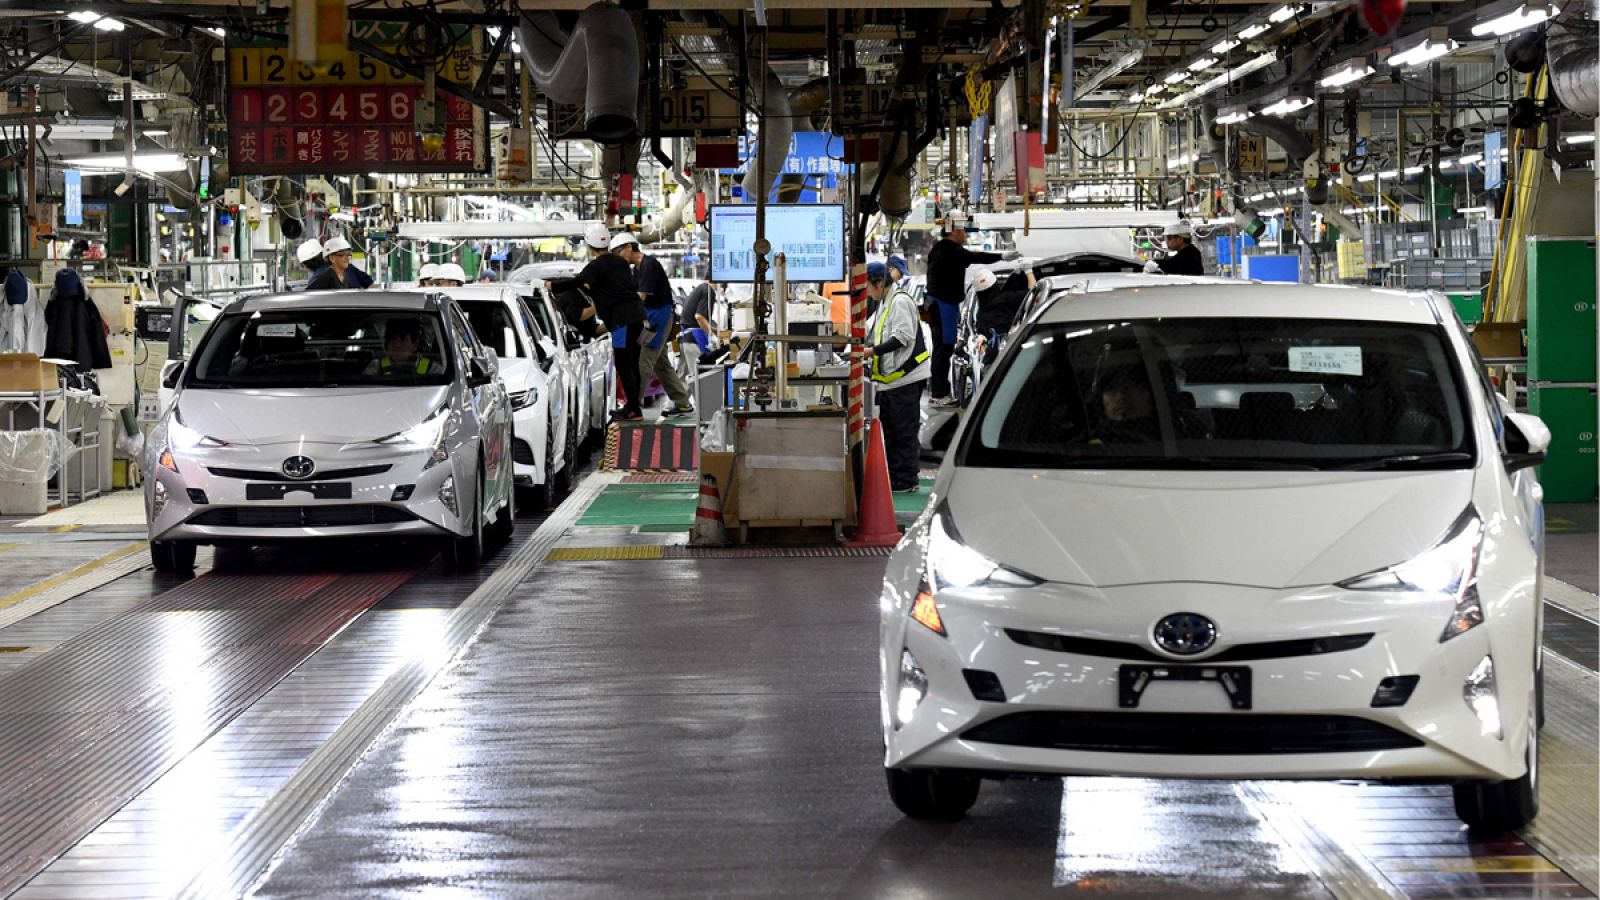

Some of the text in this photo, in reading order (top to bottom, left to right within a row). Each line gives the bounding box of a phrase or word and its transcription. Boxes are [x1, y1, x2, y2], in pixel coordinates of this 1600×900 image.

[242, 55, 248, 82] 1
[267, 55, 285, 81] 2
[328, 61, 346, 80] 4
[359, 54, 376, 80] 5
[243, 91, 409, 122] 1 2 3 4 5 6
